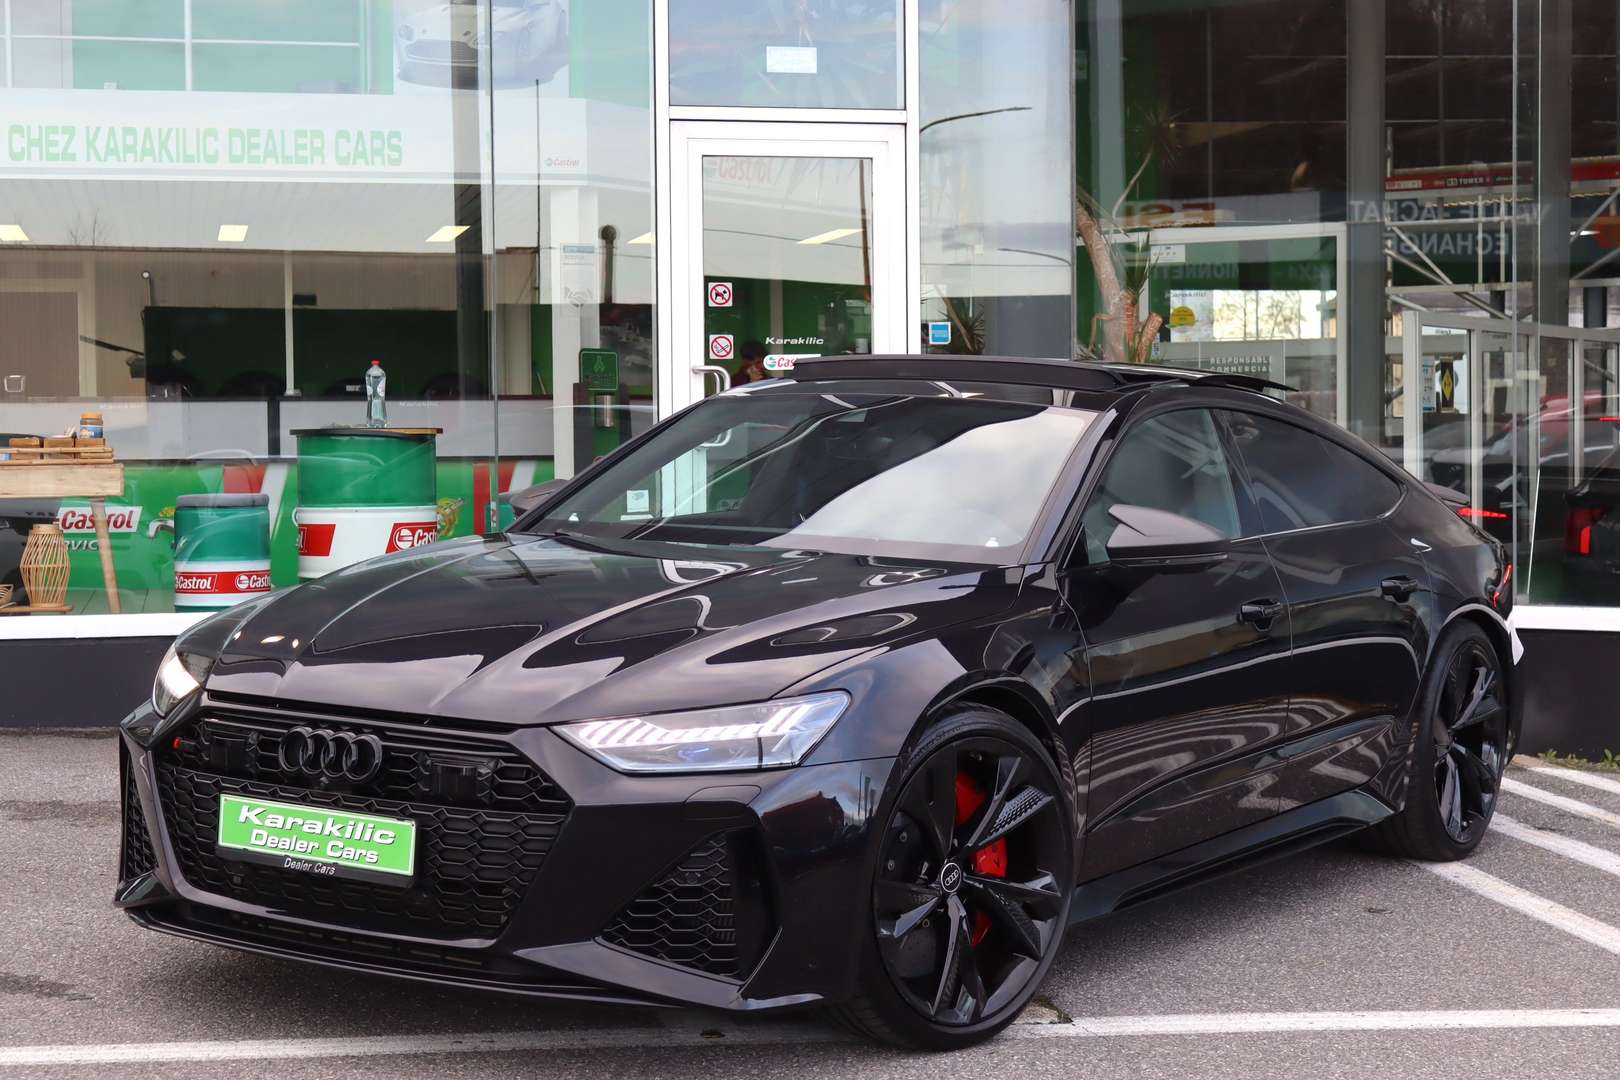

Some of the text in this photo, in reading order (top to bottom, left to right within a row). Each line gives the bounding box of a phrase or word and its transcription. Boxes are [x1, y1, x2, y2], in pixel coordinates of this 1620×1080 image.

[8, 124, 403, 166] CHEZ KARAKILIC DEALER CARS
[765, 336, 824, 345] Karakilic
[61, 510, 134, 530] Casrol
[178, 576, 212, 590] Castrol
[249, 574, 271, 589] Cast
[238, 805, 396, 845] Karakilic
[250, 829, 379, 864] Dealer Cars
[284, 857, 336, 875] Dealer Cars
